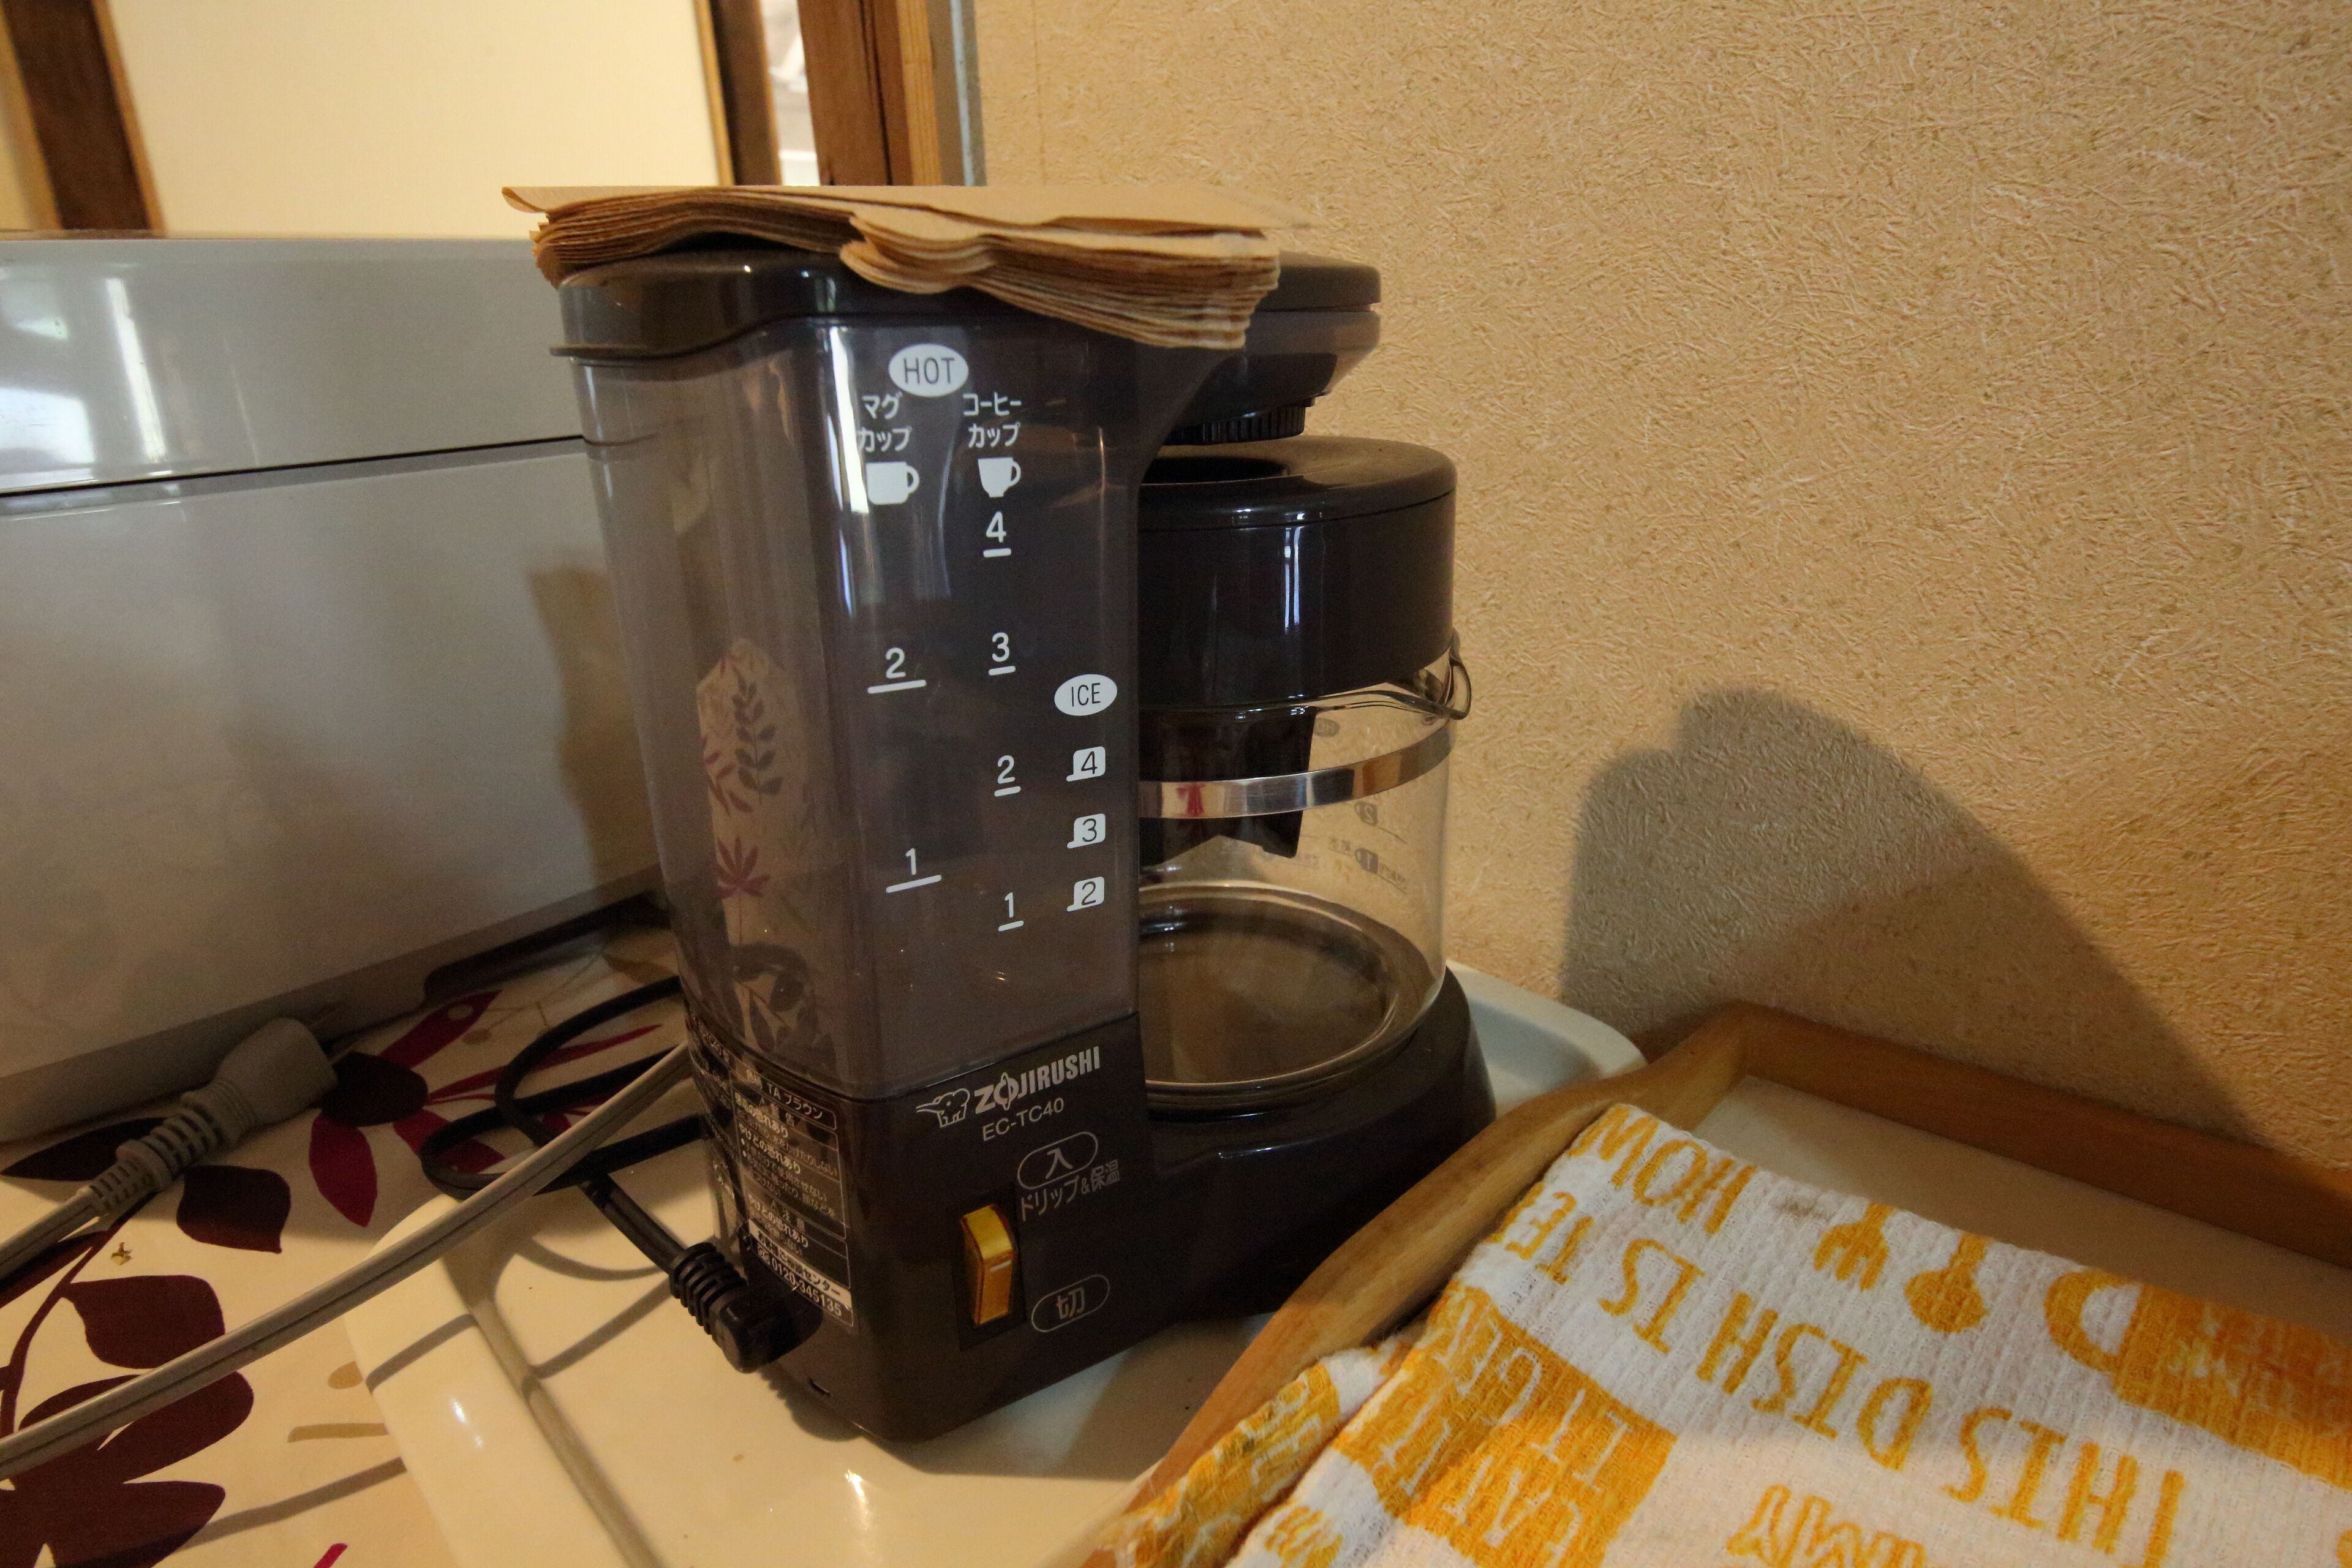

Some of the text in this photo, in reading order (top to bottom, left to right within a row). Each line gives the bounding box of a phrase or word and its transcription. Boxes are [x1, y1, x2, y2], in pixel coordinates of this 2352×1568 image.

[903, 357, 956, 385] HOT
[862, 390, 903, 420] マグ
[963, 392, 1022, 417] コーヒー
[968, 422, 1021, 448] カップ
[986, 511, 1007, 543] 4
[991, 631, 1011, 662] 3
[885, 647, 907, 679] 2
[1071, 682, 1101, 707] ICE
[997, 755, 1016, 784] 2
[1080, 751, 1098, 775] 4
[1082, 818, 1098, 843] 3
[905, 848, 917, 875] 1
[1004, 892, 1014, 918] 1
[1080, 881, 1097, 906] 2
[767, 1082, 781, 1100] TA
[974, 1046, 1101, 1115] ZOJIRUSHI
[982, 1098, 1065, 1141] EC-TC40
[1046, 1148, 1073, 1179] 入
[1020, 1159, 1120, 1222] ドリップ&保温
[1056, 1287, 1085, 1320] 切
[1598, 1238, 1705, 1352] IS
[1695, 1292, 1933, 1470] DISH
[1530, 1387, 1634, 1494] IT
[1944, 1406, 2185, 1568] THIS
